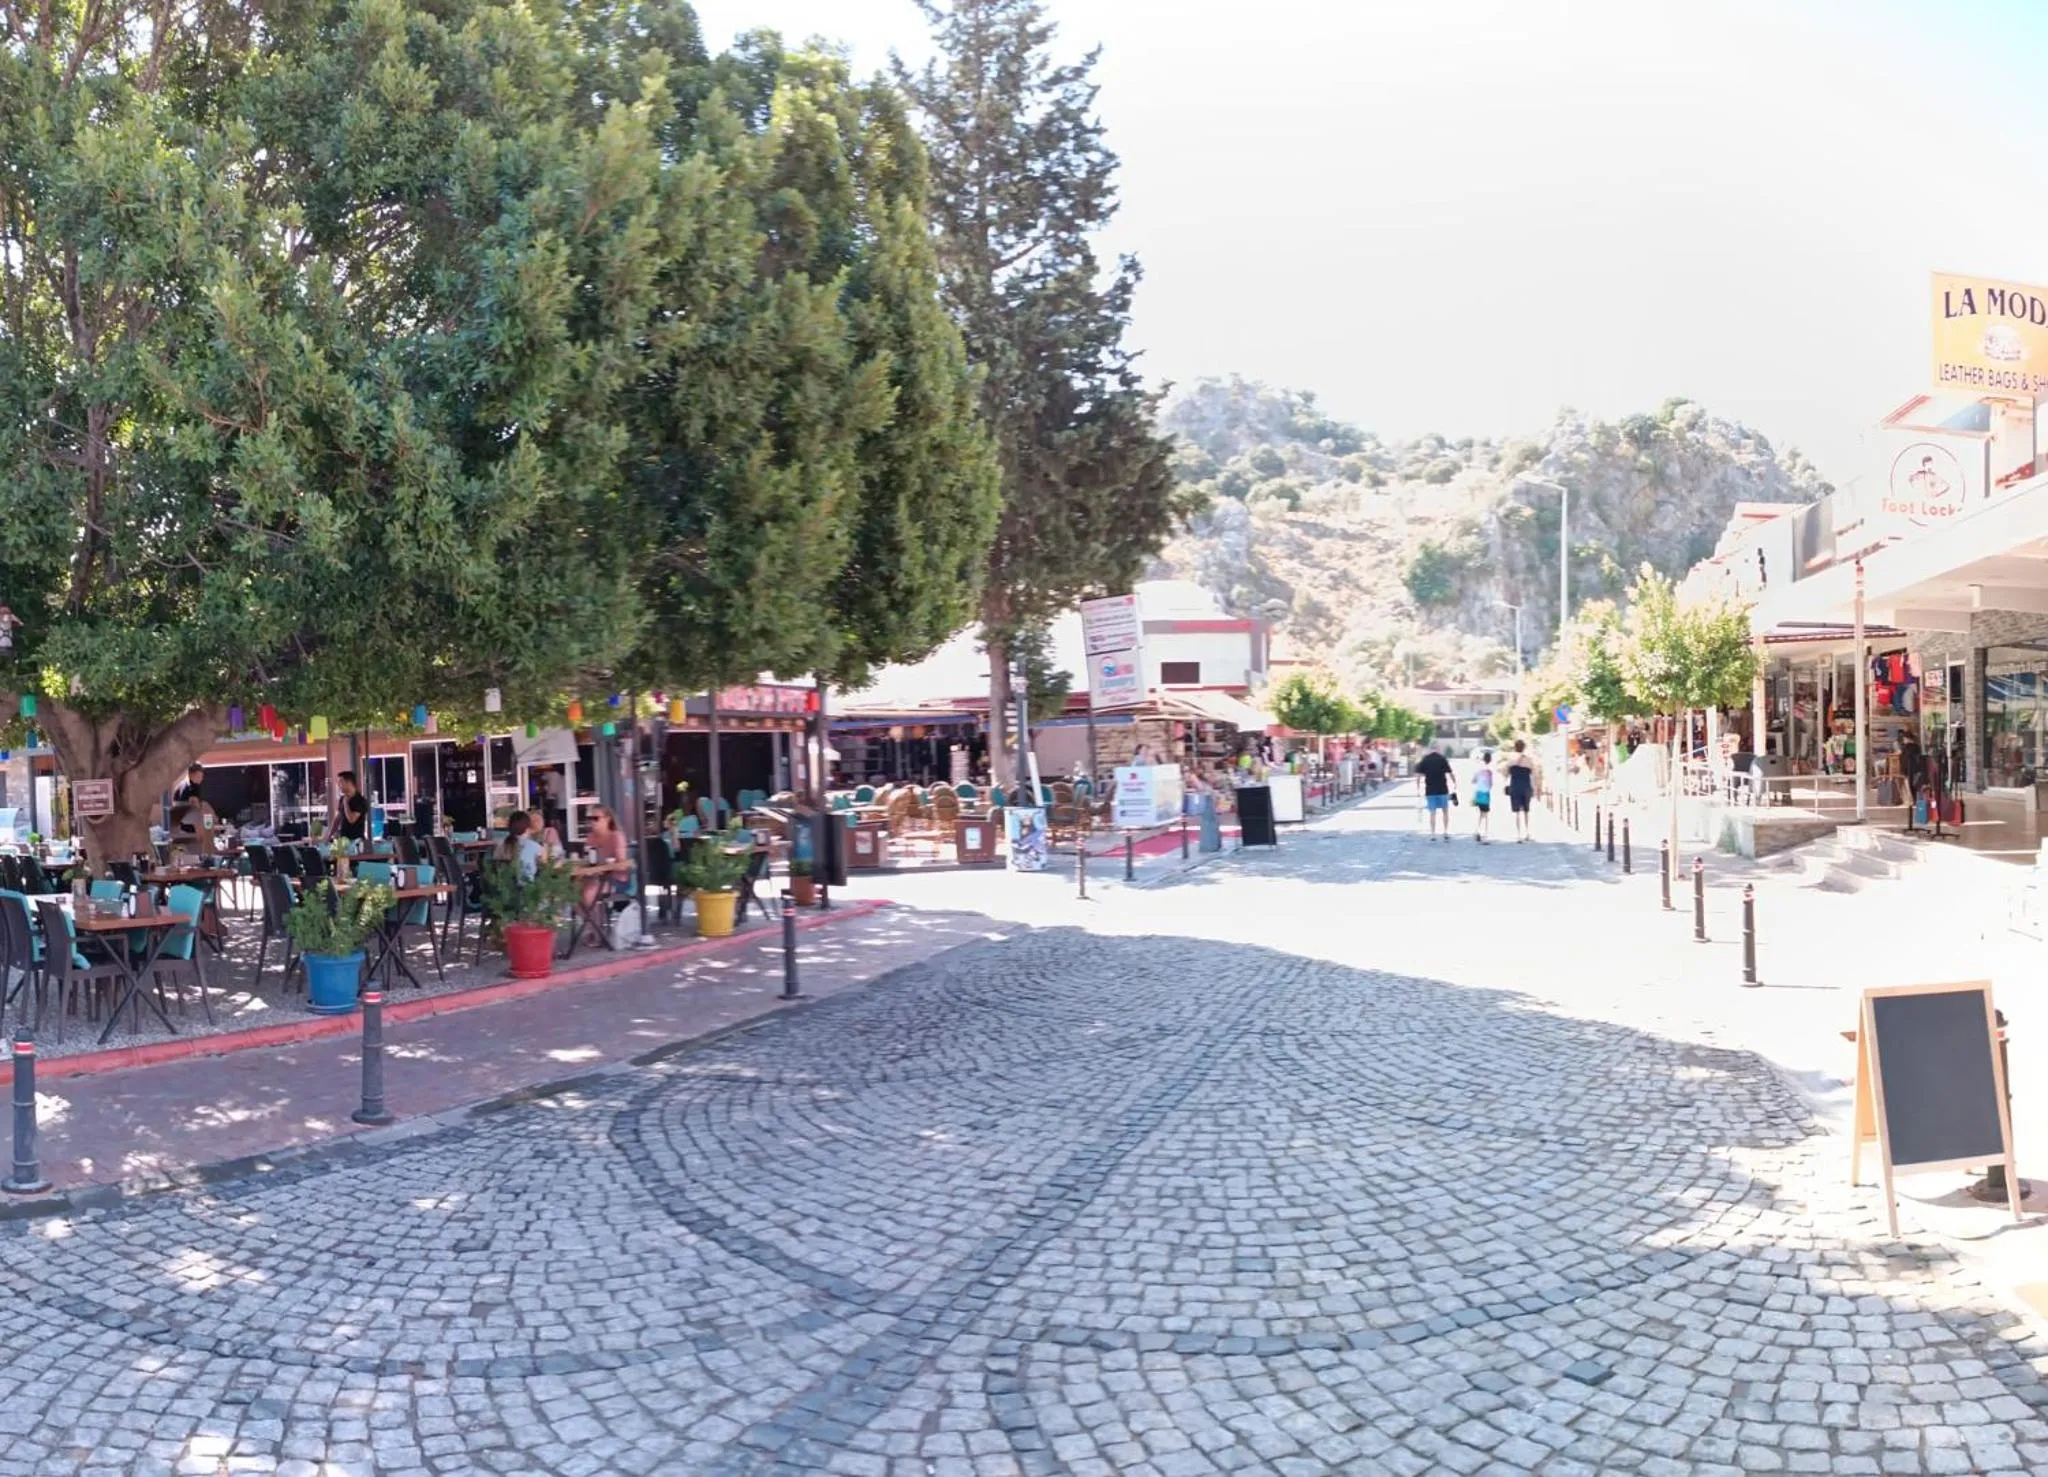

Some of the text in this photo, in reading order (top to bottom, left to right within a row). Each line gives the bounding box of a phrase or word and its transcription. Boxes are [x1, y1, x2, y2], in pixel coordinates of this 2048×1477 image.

[1944, 288, 2048, 328] LA MOD
[1939, 362, 1985, 385] LEATHER
[1988, 369, 2018, 389] BAGS
[2021, 373, 2029, 391] &
